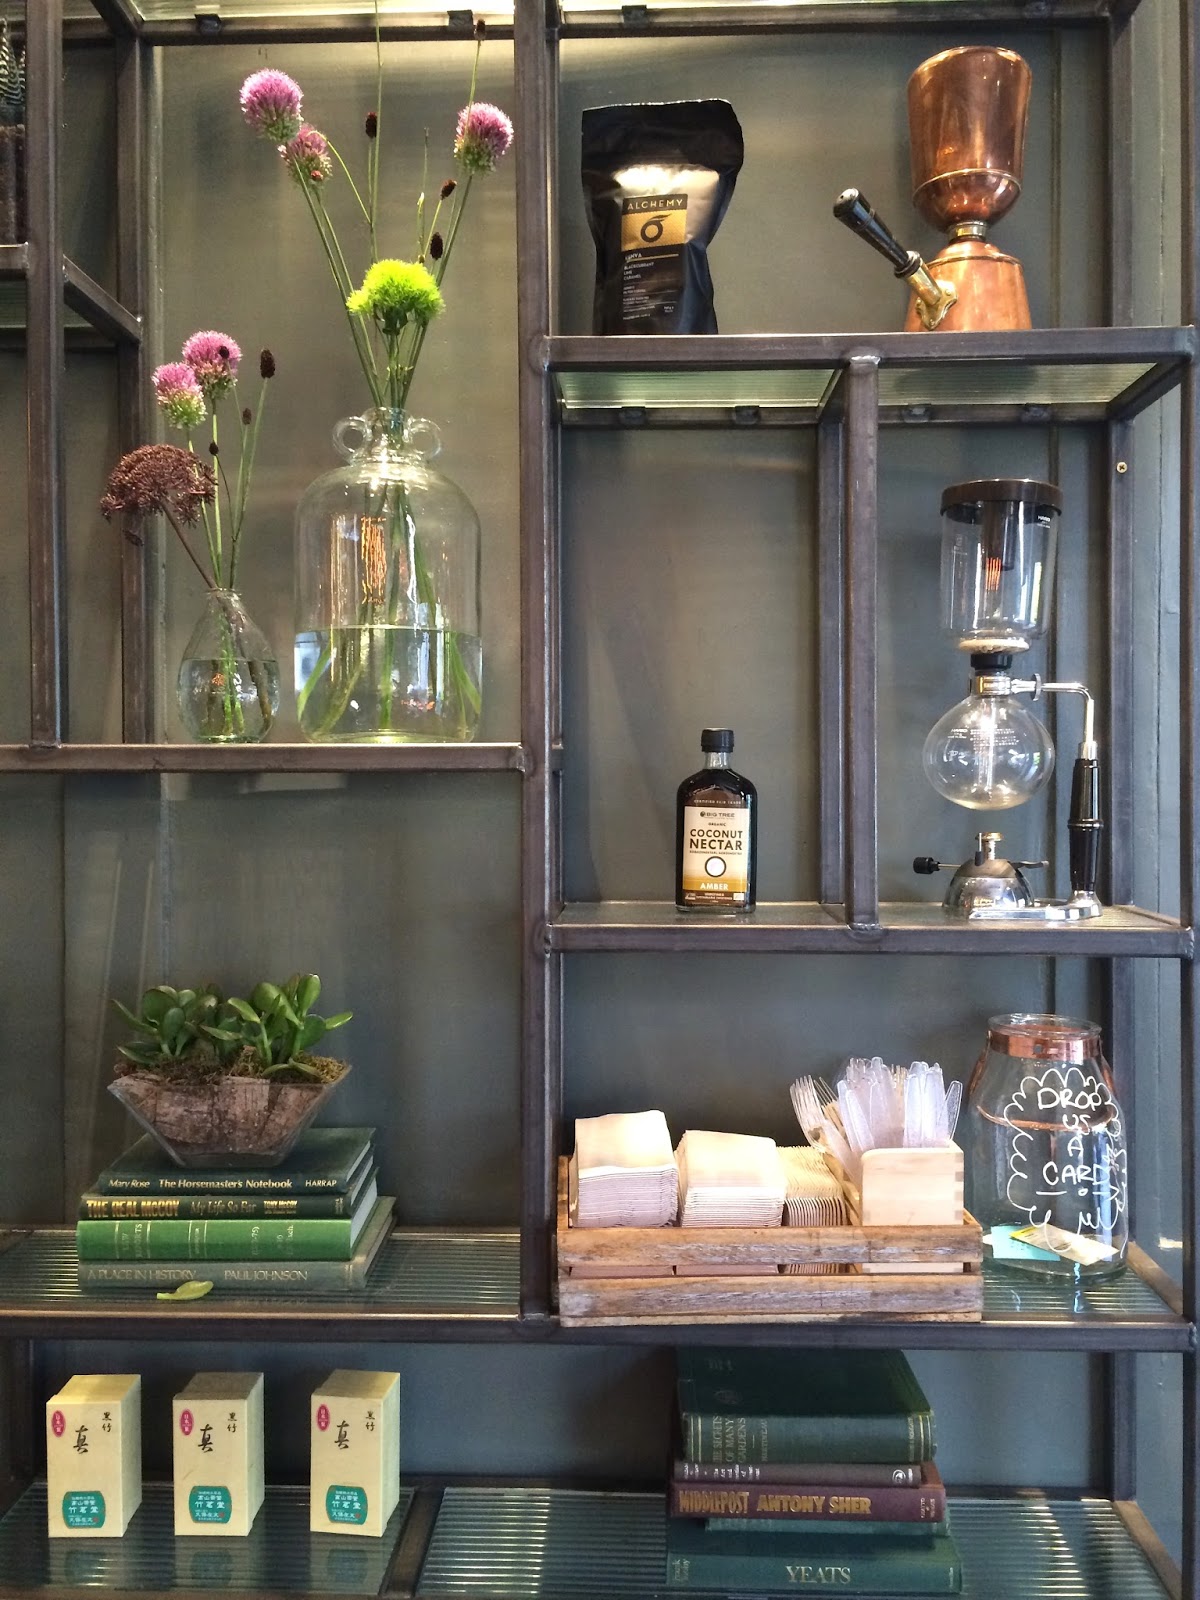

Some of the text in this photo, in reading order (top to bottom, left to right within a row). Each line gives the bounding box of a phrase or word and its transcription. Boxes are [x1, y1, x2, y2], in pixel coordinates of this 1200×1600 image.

[627, 198, 684, 210] ALCHEMY
[690, 828, 743, 838] COCONUT
[689, 838, 743, 851] NECTAR
[700, 882, 729, 890] AMBER
[1037, 1087, 1102, 1111] DROP
[1062, 1113, 1090, 1136] US
[1067, 1136, 1084, 1157] A
[108, 1178, 150, 1189] Mary Rose
[159, 1178, 293, 1189] The Horsemaster's Notebook
[305, 1178, 337, 1188] HARRAP
[1042, 1161, 1110, 1187] CARD
[86, 1199, 110, 1218] THE
[111, 1199, 140, 1217] REAL
[190, 1200, 205, 1215] My
[206, 1200, 227, 1215] Life
[227, 1200, 239, 1213] So
[240, 1200, 257, 1213] Far
[98, 1269, 132, 1280] PLACE
[133, 1269, 147, 1280] IN
[149, 1269, 197, 1281] HISTORY
[224, 1270, 308, 1281] PAUL JOHNSON
[73, 1425, 89, 1454] 真
[198, 1423, 213, 1453] 真
[334, 1420, 350, 1450] 真
[725, 1418, 735, 1448] MANY
[737, 1417, 747, 1463] GARDENS
[678, 1490, 750, 1514] MIDDLEPOST
[757, 1494, 872, 1514] ANTONY SHER
[785, 1565, 851, 1584] YEATS
